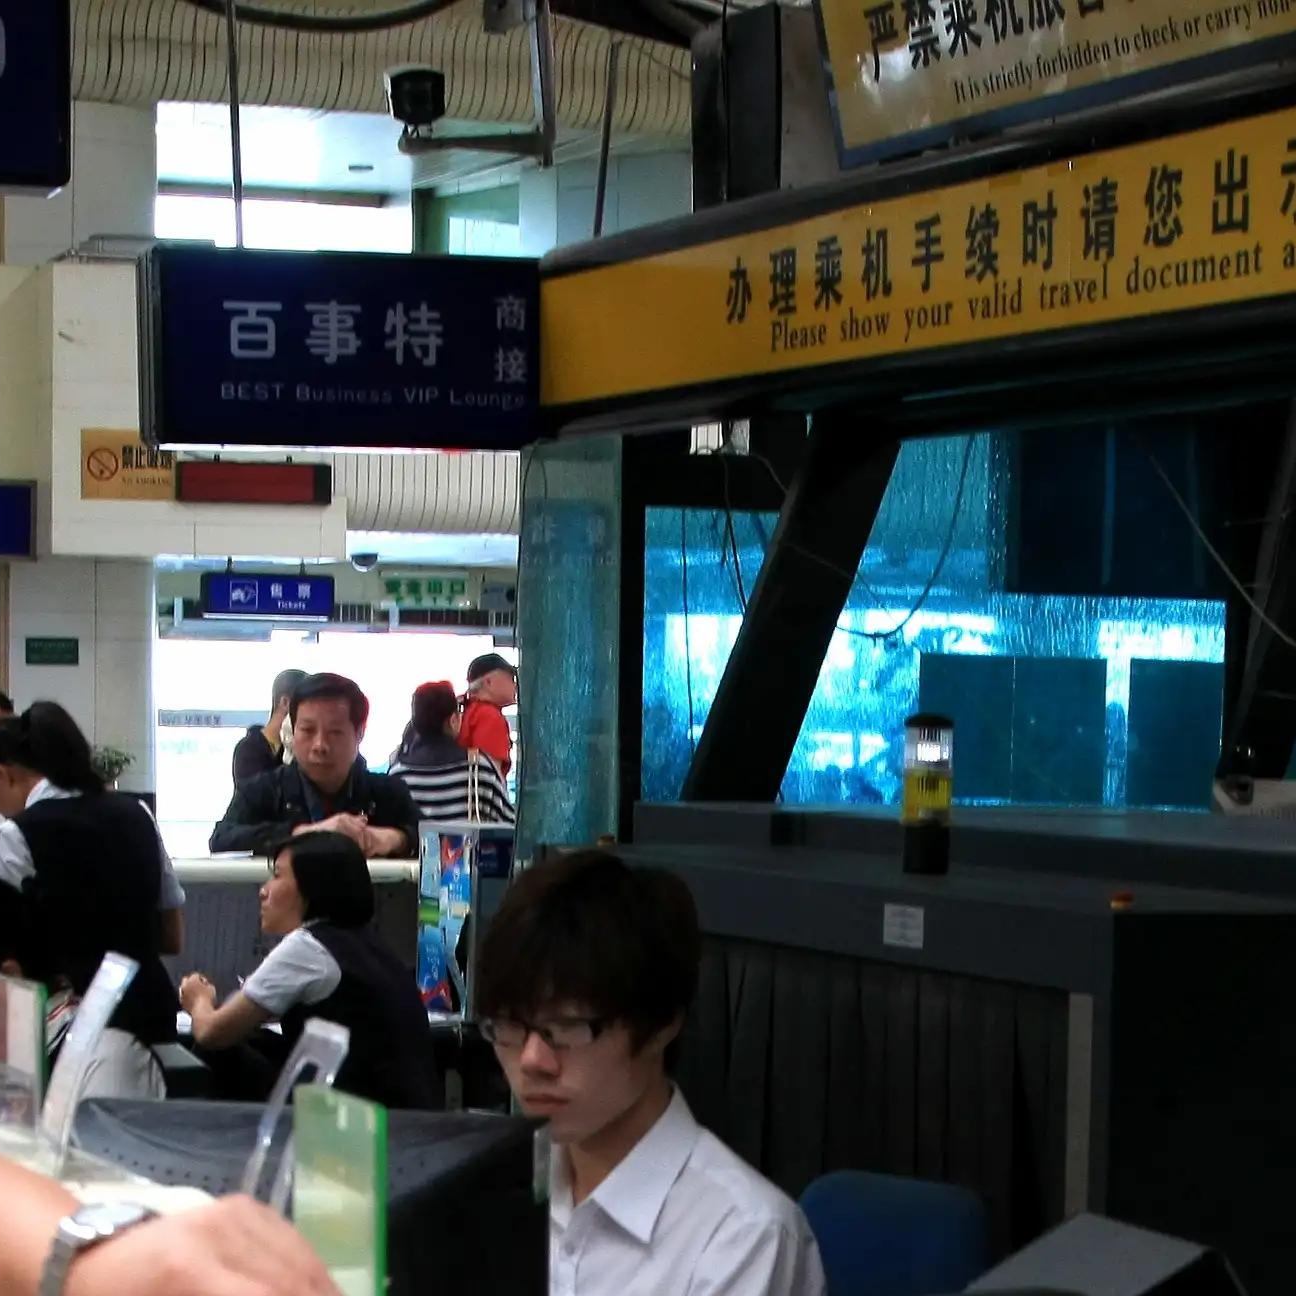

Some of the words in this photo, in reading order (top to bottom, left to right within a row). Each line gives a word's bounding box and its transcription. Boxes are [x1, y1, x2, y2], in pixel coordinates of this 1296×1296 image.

[954, 81, 967, 104] It
[970, 78, 982, 100] is
[982, 59, 1034, 96] strictly
[1035, 38, 1112, 81] forbidden
[1115, 35, 1131, 57] to
[1134, 16, 1180, 51] check
[1184, 14, 1202, 37] or
[1205, 3, 1253, 34] carry
[222, 298, 445, 367] 百事特
[770, 318, 828, 353] Please
[840, 307, 891, 342] show
[903, 301, 954, 343] your
[967, 277, 1023, 321] valid
[1039, 260, 1109, 312] travel
[1125, 240, 1263, 295] document
[220, 381, 286, 401] BEST
[295, 383, 393, 405] Business
[403, 385, 441, 405] VIP
[449, 388, 525, 412] Lounge
